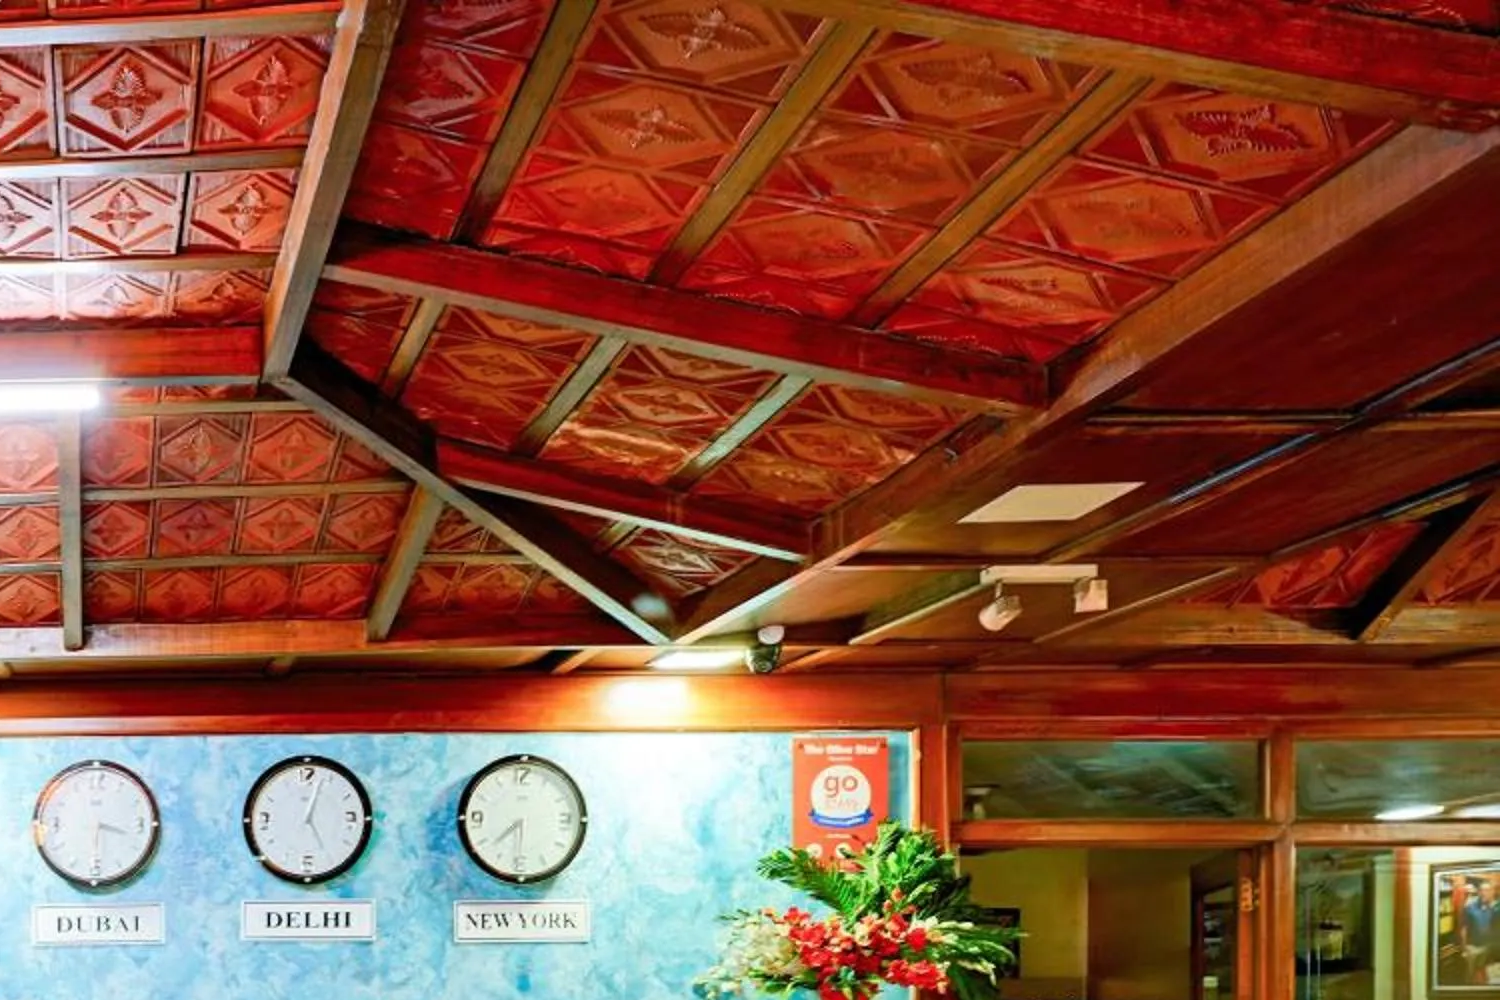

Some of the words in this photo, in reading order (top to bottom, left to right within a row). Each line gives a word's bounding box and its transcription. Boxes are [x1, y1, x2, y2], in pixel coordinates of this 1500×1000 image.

[824, 775, 859, 798] go
[56, 915, 142, 933] DUBAI
[265, 911, 352, 929] DELHI
